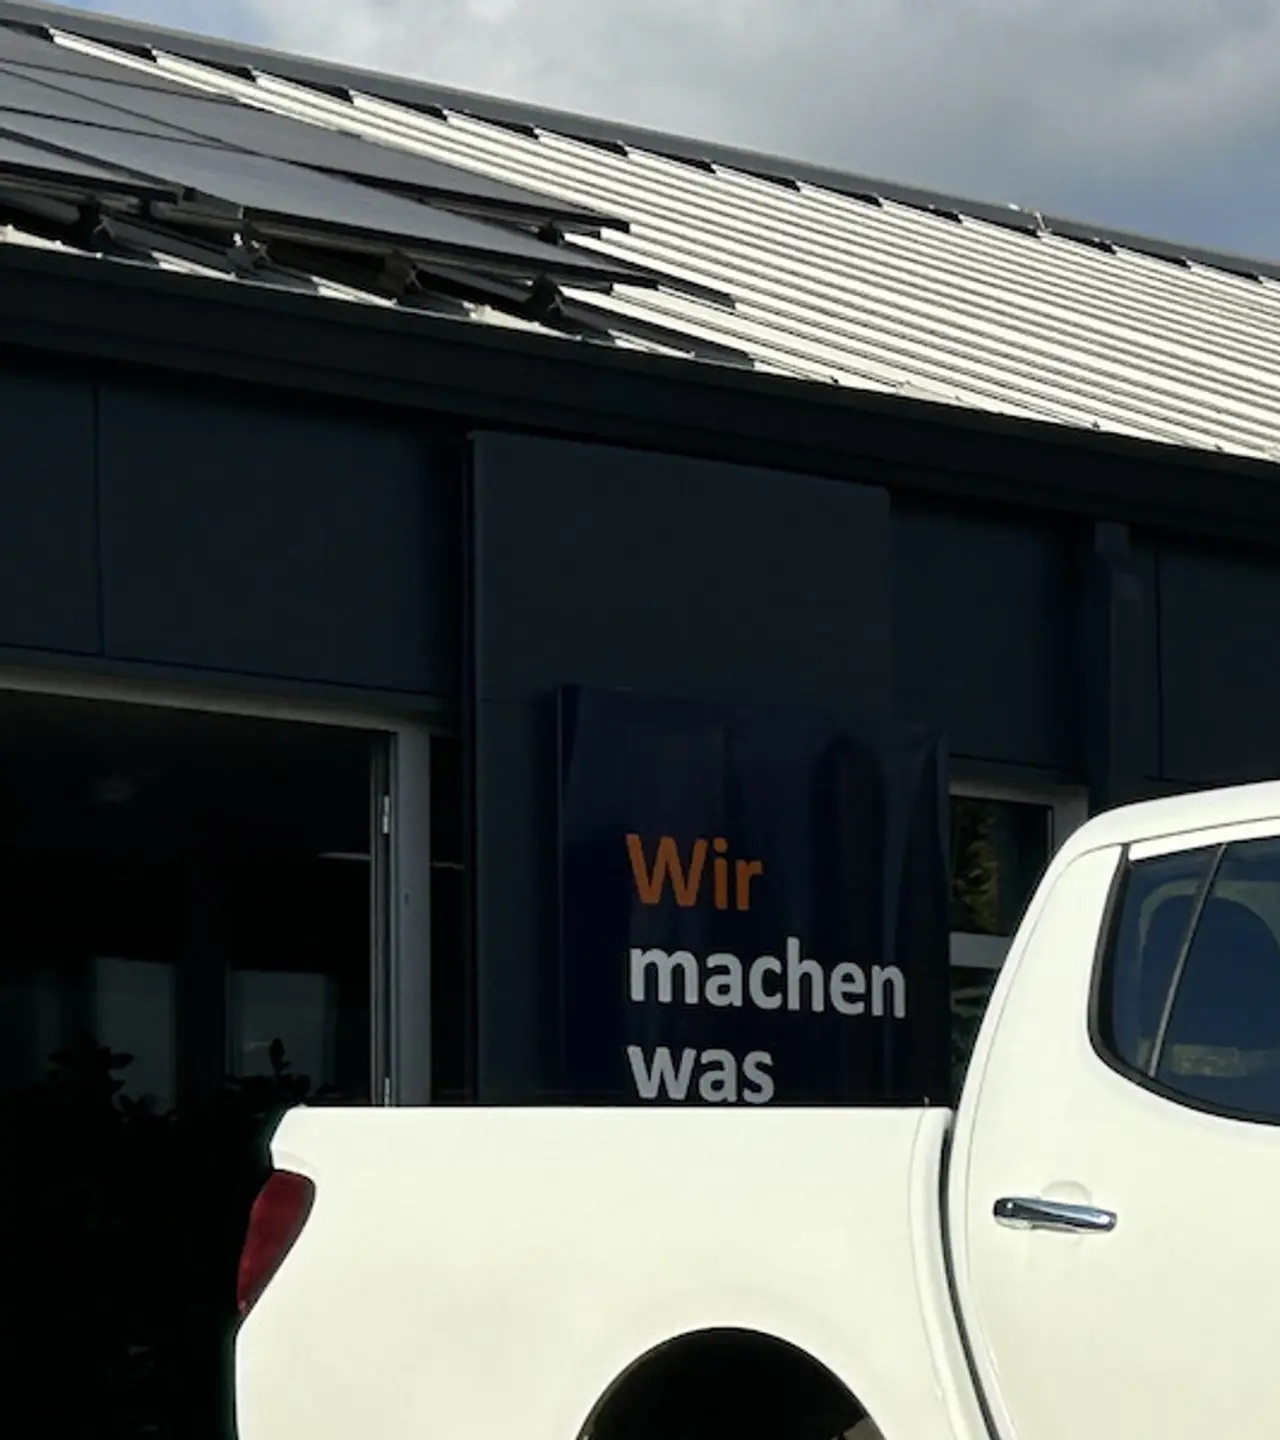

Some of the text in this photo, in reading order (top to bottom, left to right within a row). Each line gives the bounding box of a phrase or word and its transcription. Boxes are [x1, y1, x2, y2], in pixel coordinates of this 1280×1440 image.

[627, 832, 764, 911] Wir
[629, 936, 907, 1019] machen
[627, 1044, 776, 1105] was
